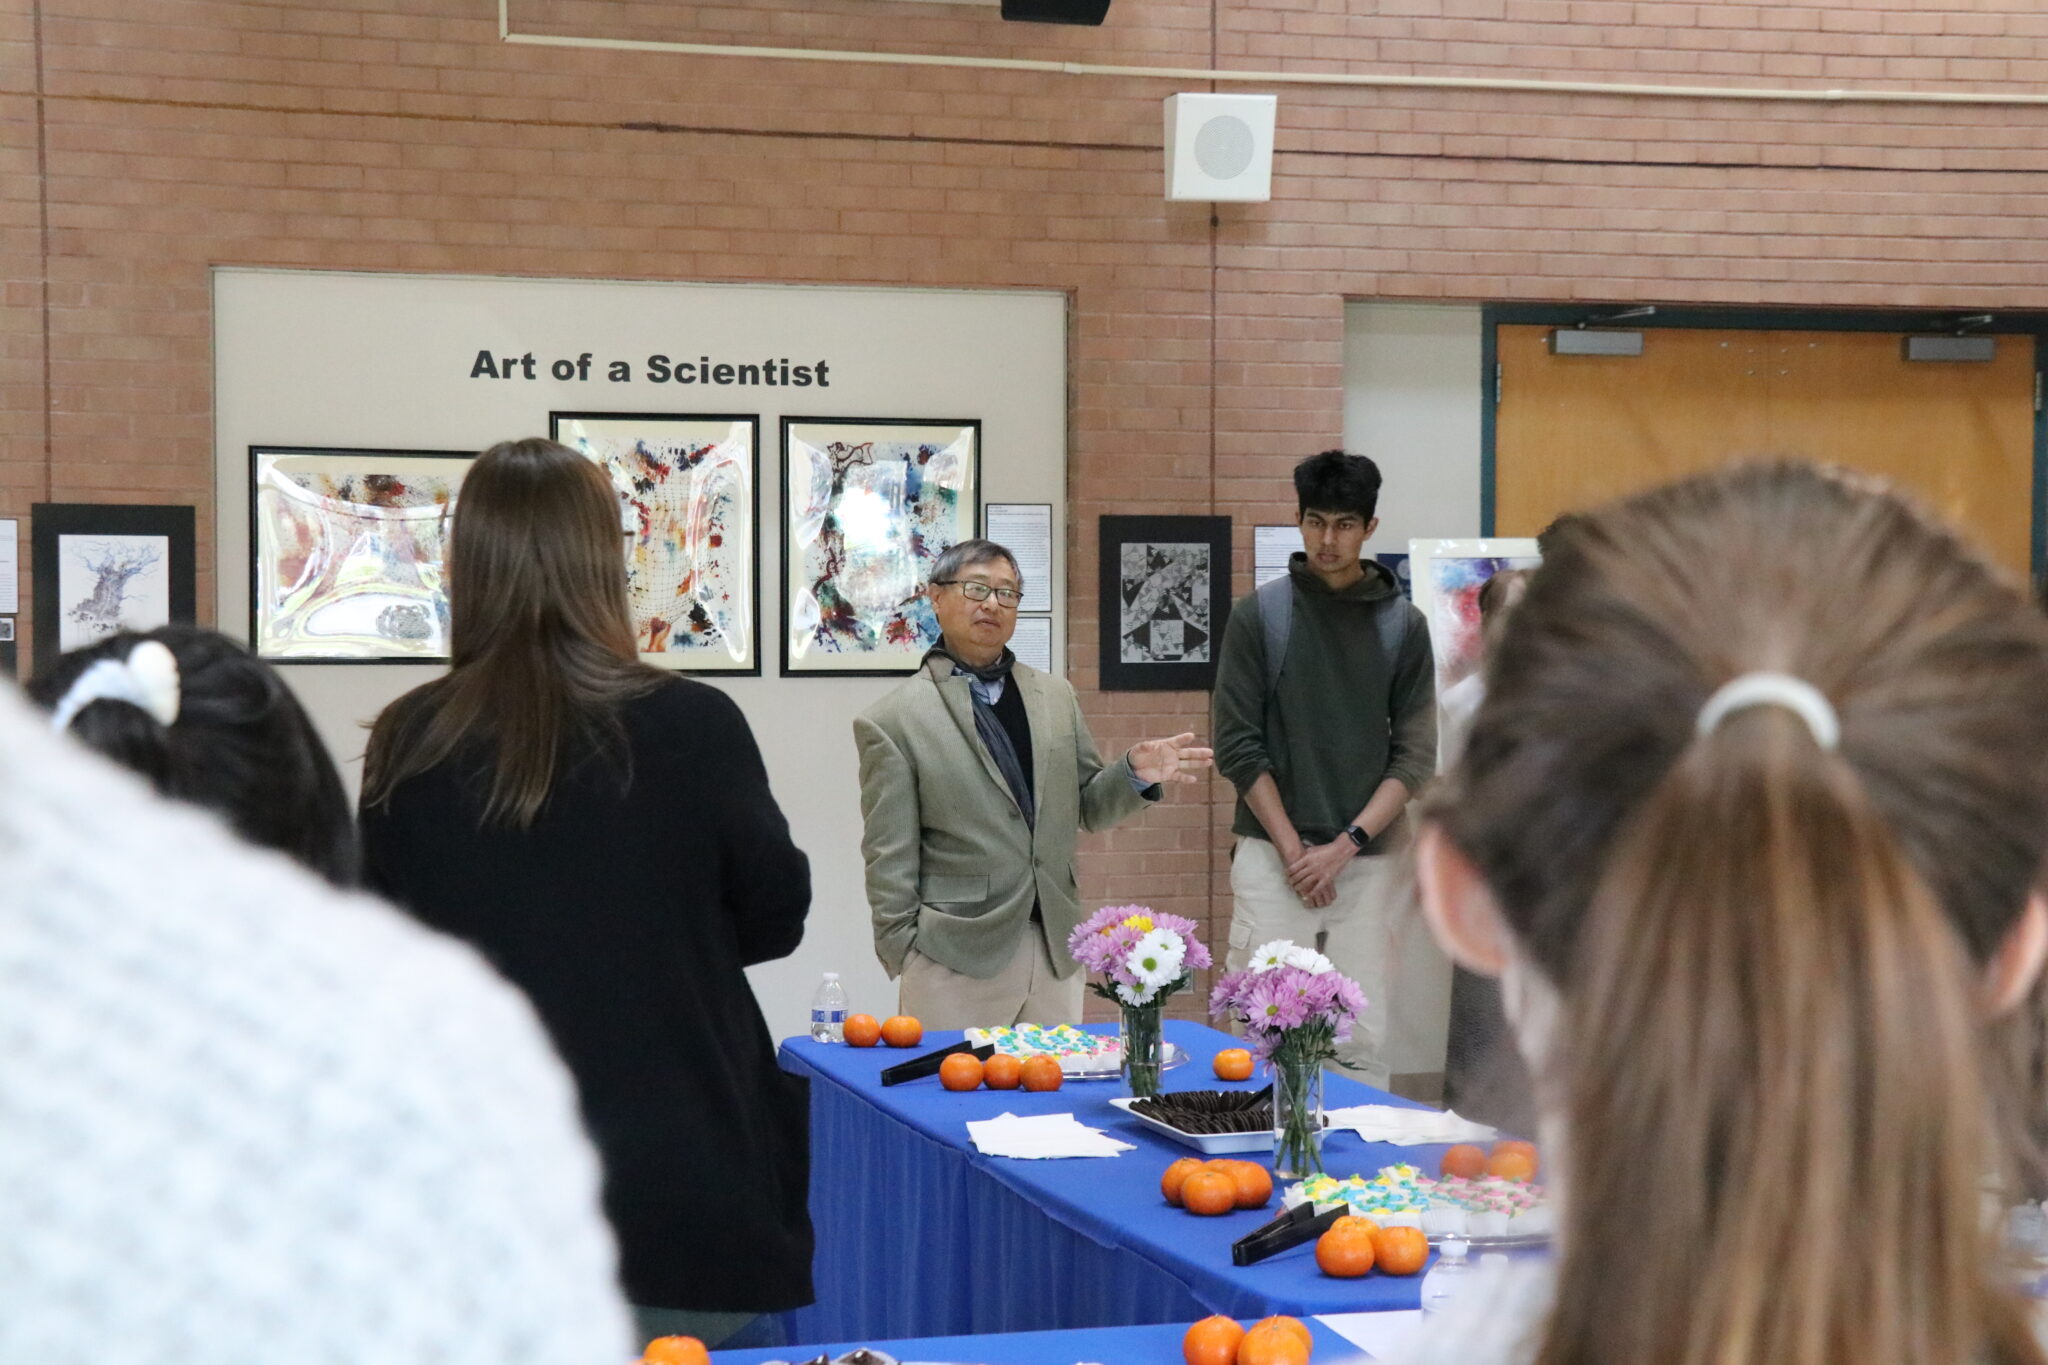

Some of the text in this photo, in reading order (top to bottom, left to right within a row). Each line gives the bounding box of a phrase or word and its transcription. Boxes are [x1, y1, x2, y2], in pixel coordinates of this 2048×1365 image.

[470, 350, 830, 388] Art of a Scientist
